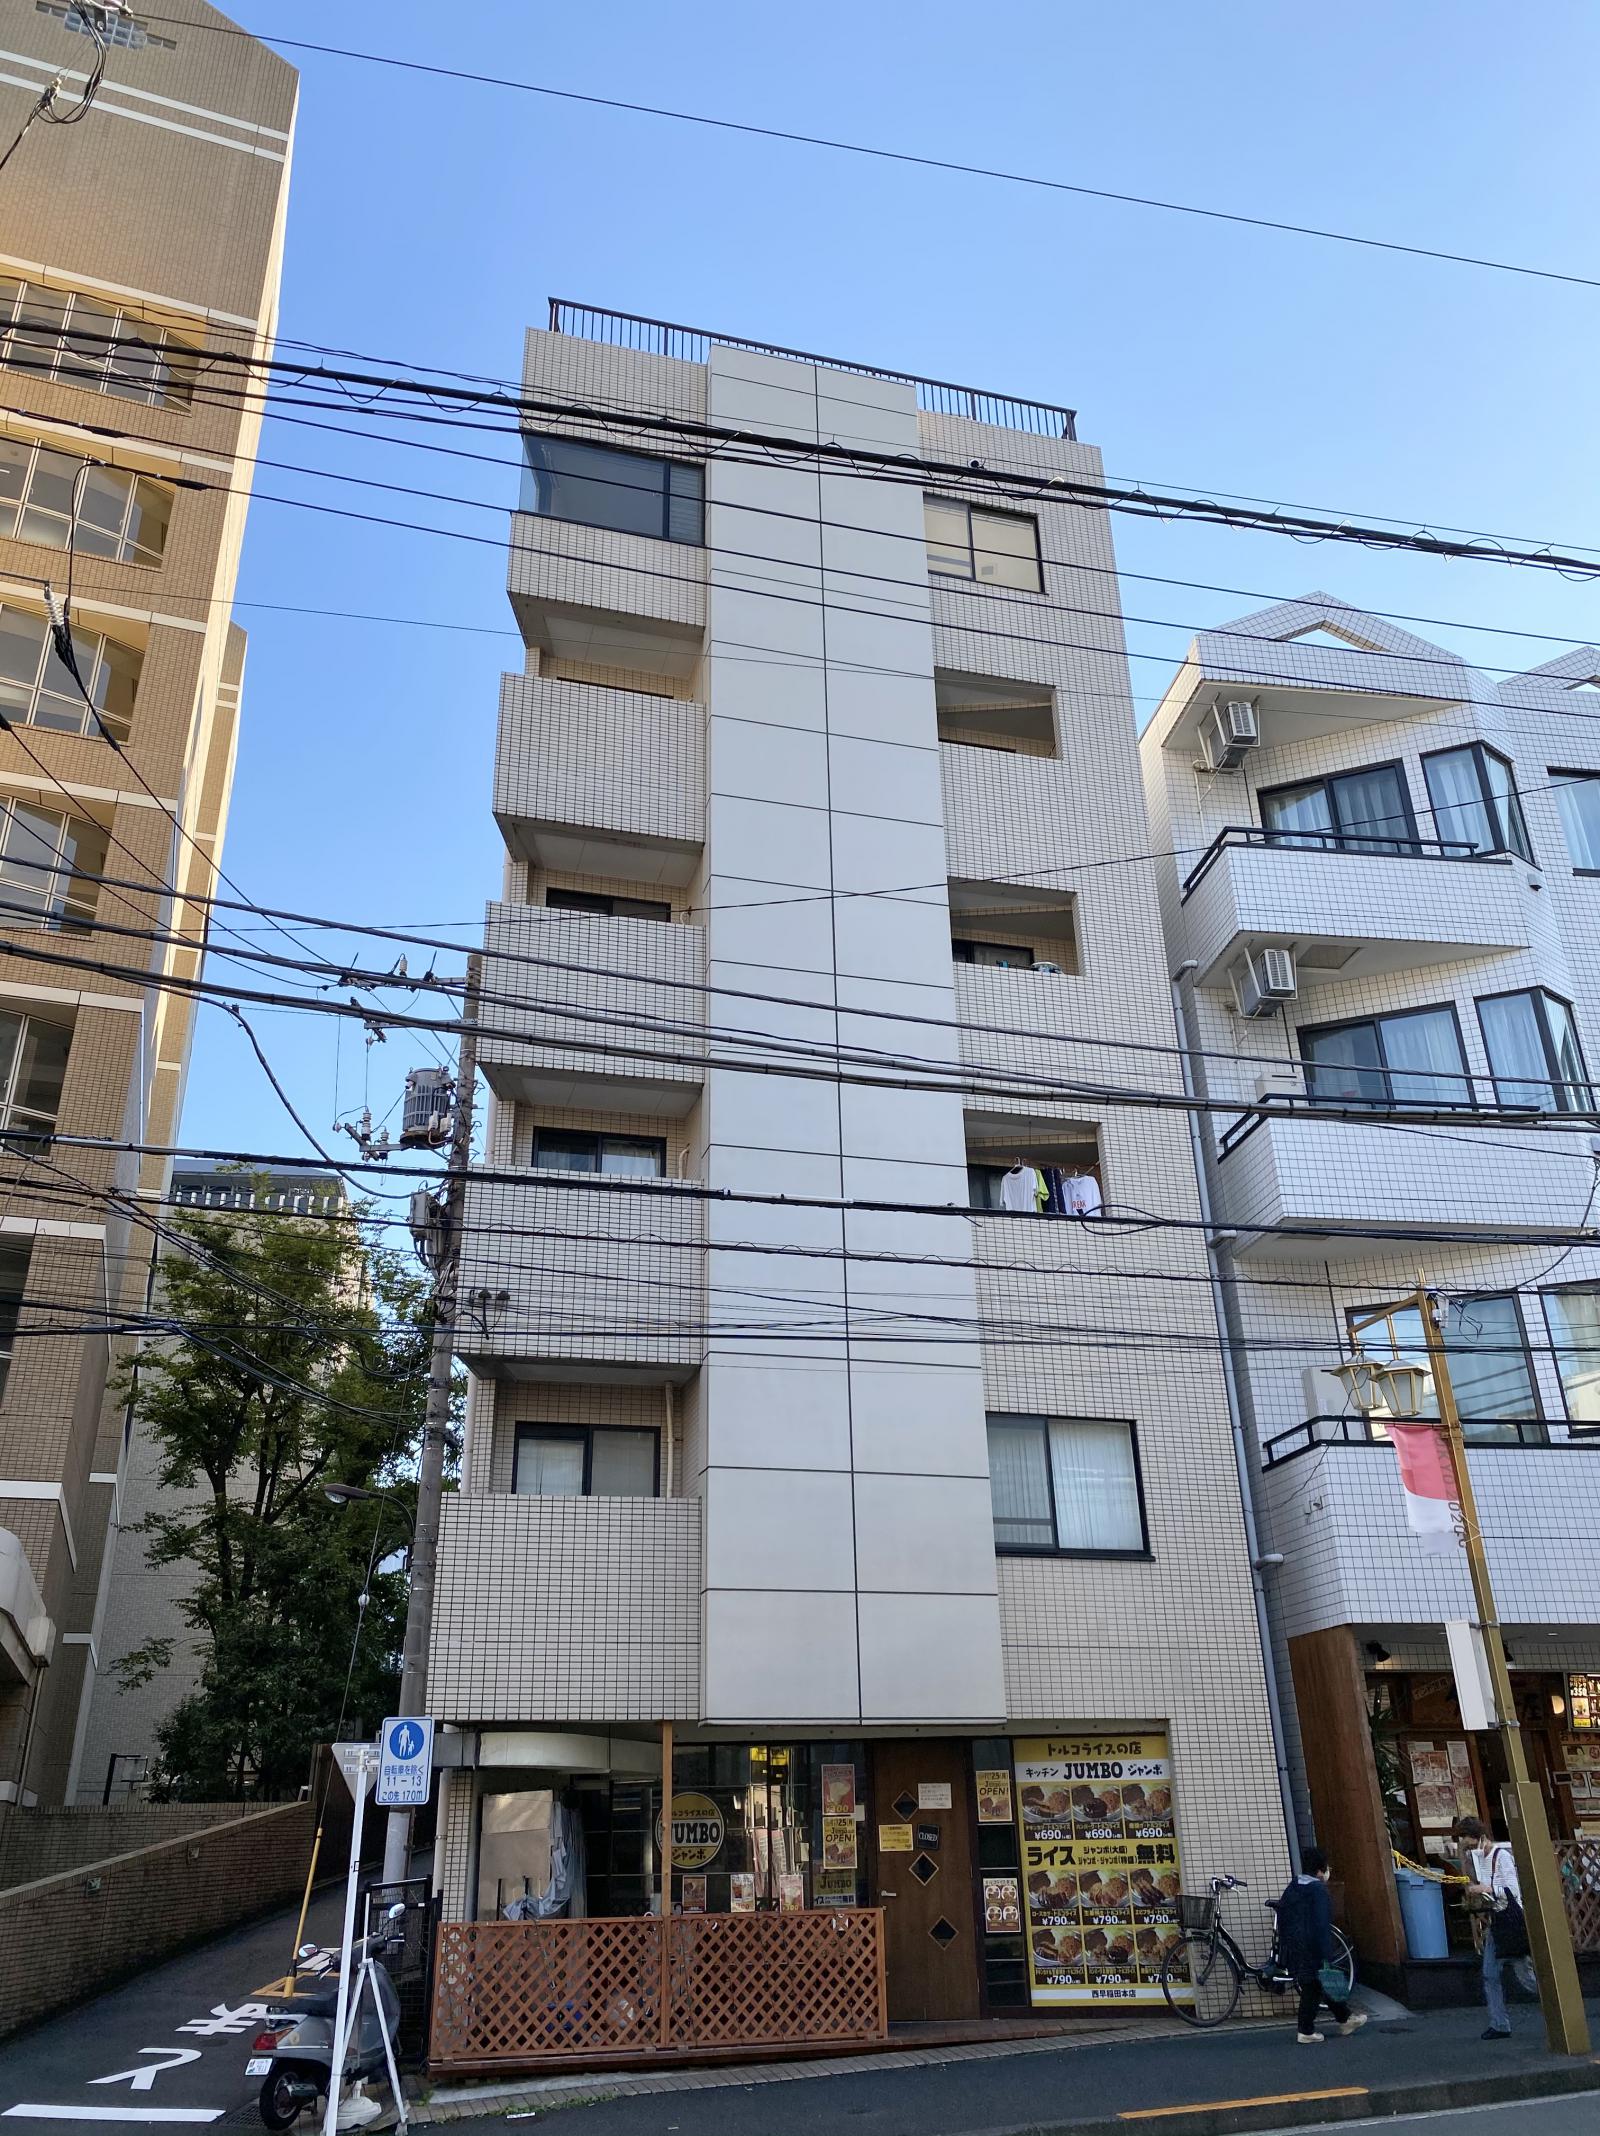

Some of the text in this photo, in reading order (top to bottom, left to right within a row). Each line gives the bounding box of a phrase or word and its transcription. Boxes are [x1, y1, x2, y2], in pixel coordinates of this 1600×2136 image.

[1047, 1741, 1142, 1757] トルコライスの店
[384, 1765, 424, 1776] 自転車を除く
[1025, 1761, 1163, 1780] キッチン JUMBO ジャンボ
[381, 1790, 423, 1801] この先 170m
[979, 1787, 1009, 1796] OPEN!
[672, 1809, 715, 1817] ルコライスの店
[1034, 1829, 1062, 1840] ¥690
[1085, 1828, 1112, 1839] ¥690
[1135, 1827, 1163, 1838] ¥690
[825, 1834, 855, 1843] OPEN!
[1027, 1845, 1076, 1866] ライス
[1135, 1843, 1176, 1865] 無料
[1042, 1915, 1068, 1925] ¥790
[1092, 1915, 1118, 1925] ¥790
[1143, 1914, 1169, 1924] ¥790
[1046, 1974, 1072, 1985] ¥790
[1095, 1974, 1121, 1984] ¥790
[1091, 1989, 1137, 1999] 西早稲田本店
